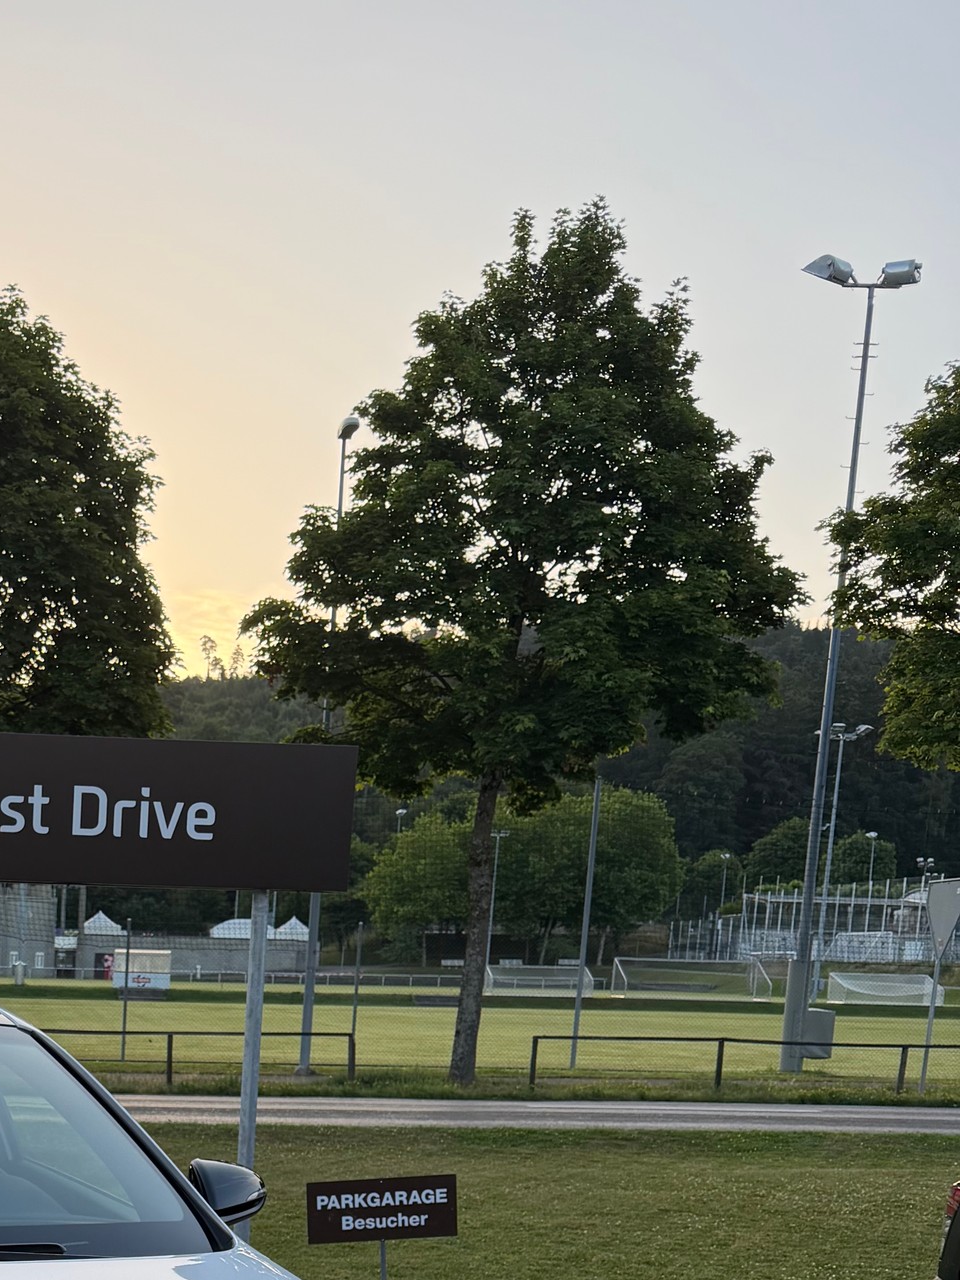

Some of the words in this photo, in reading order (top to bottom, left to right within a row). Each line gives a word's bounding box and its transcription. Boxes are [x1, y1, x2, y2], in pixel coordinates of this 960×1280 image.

[71, 785, 216, 841] Drive
[316, 1188, 447, 1210] PARKGARAGE
[341, 1213, 428, 1231] Besucher
